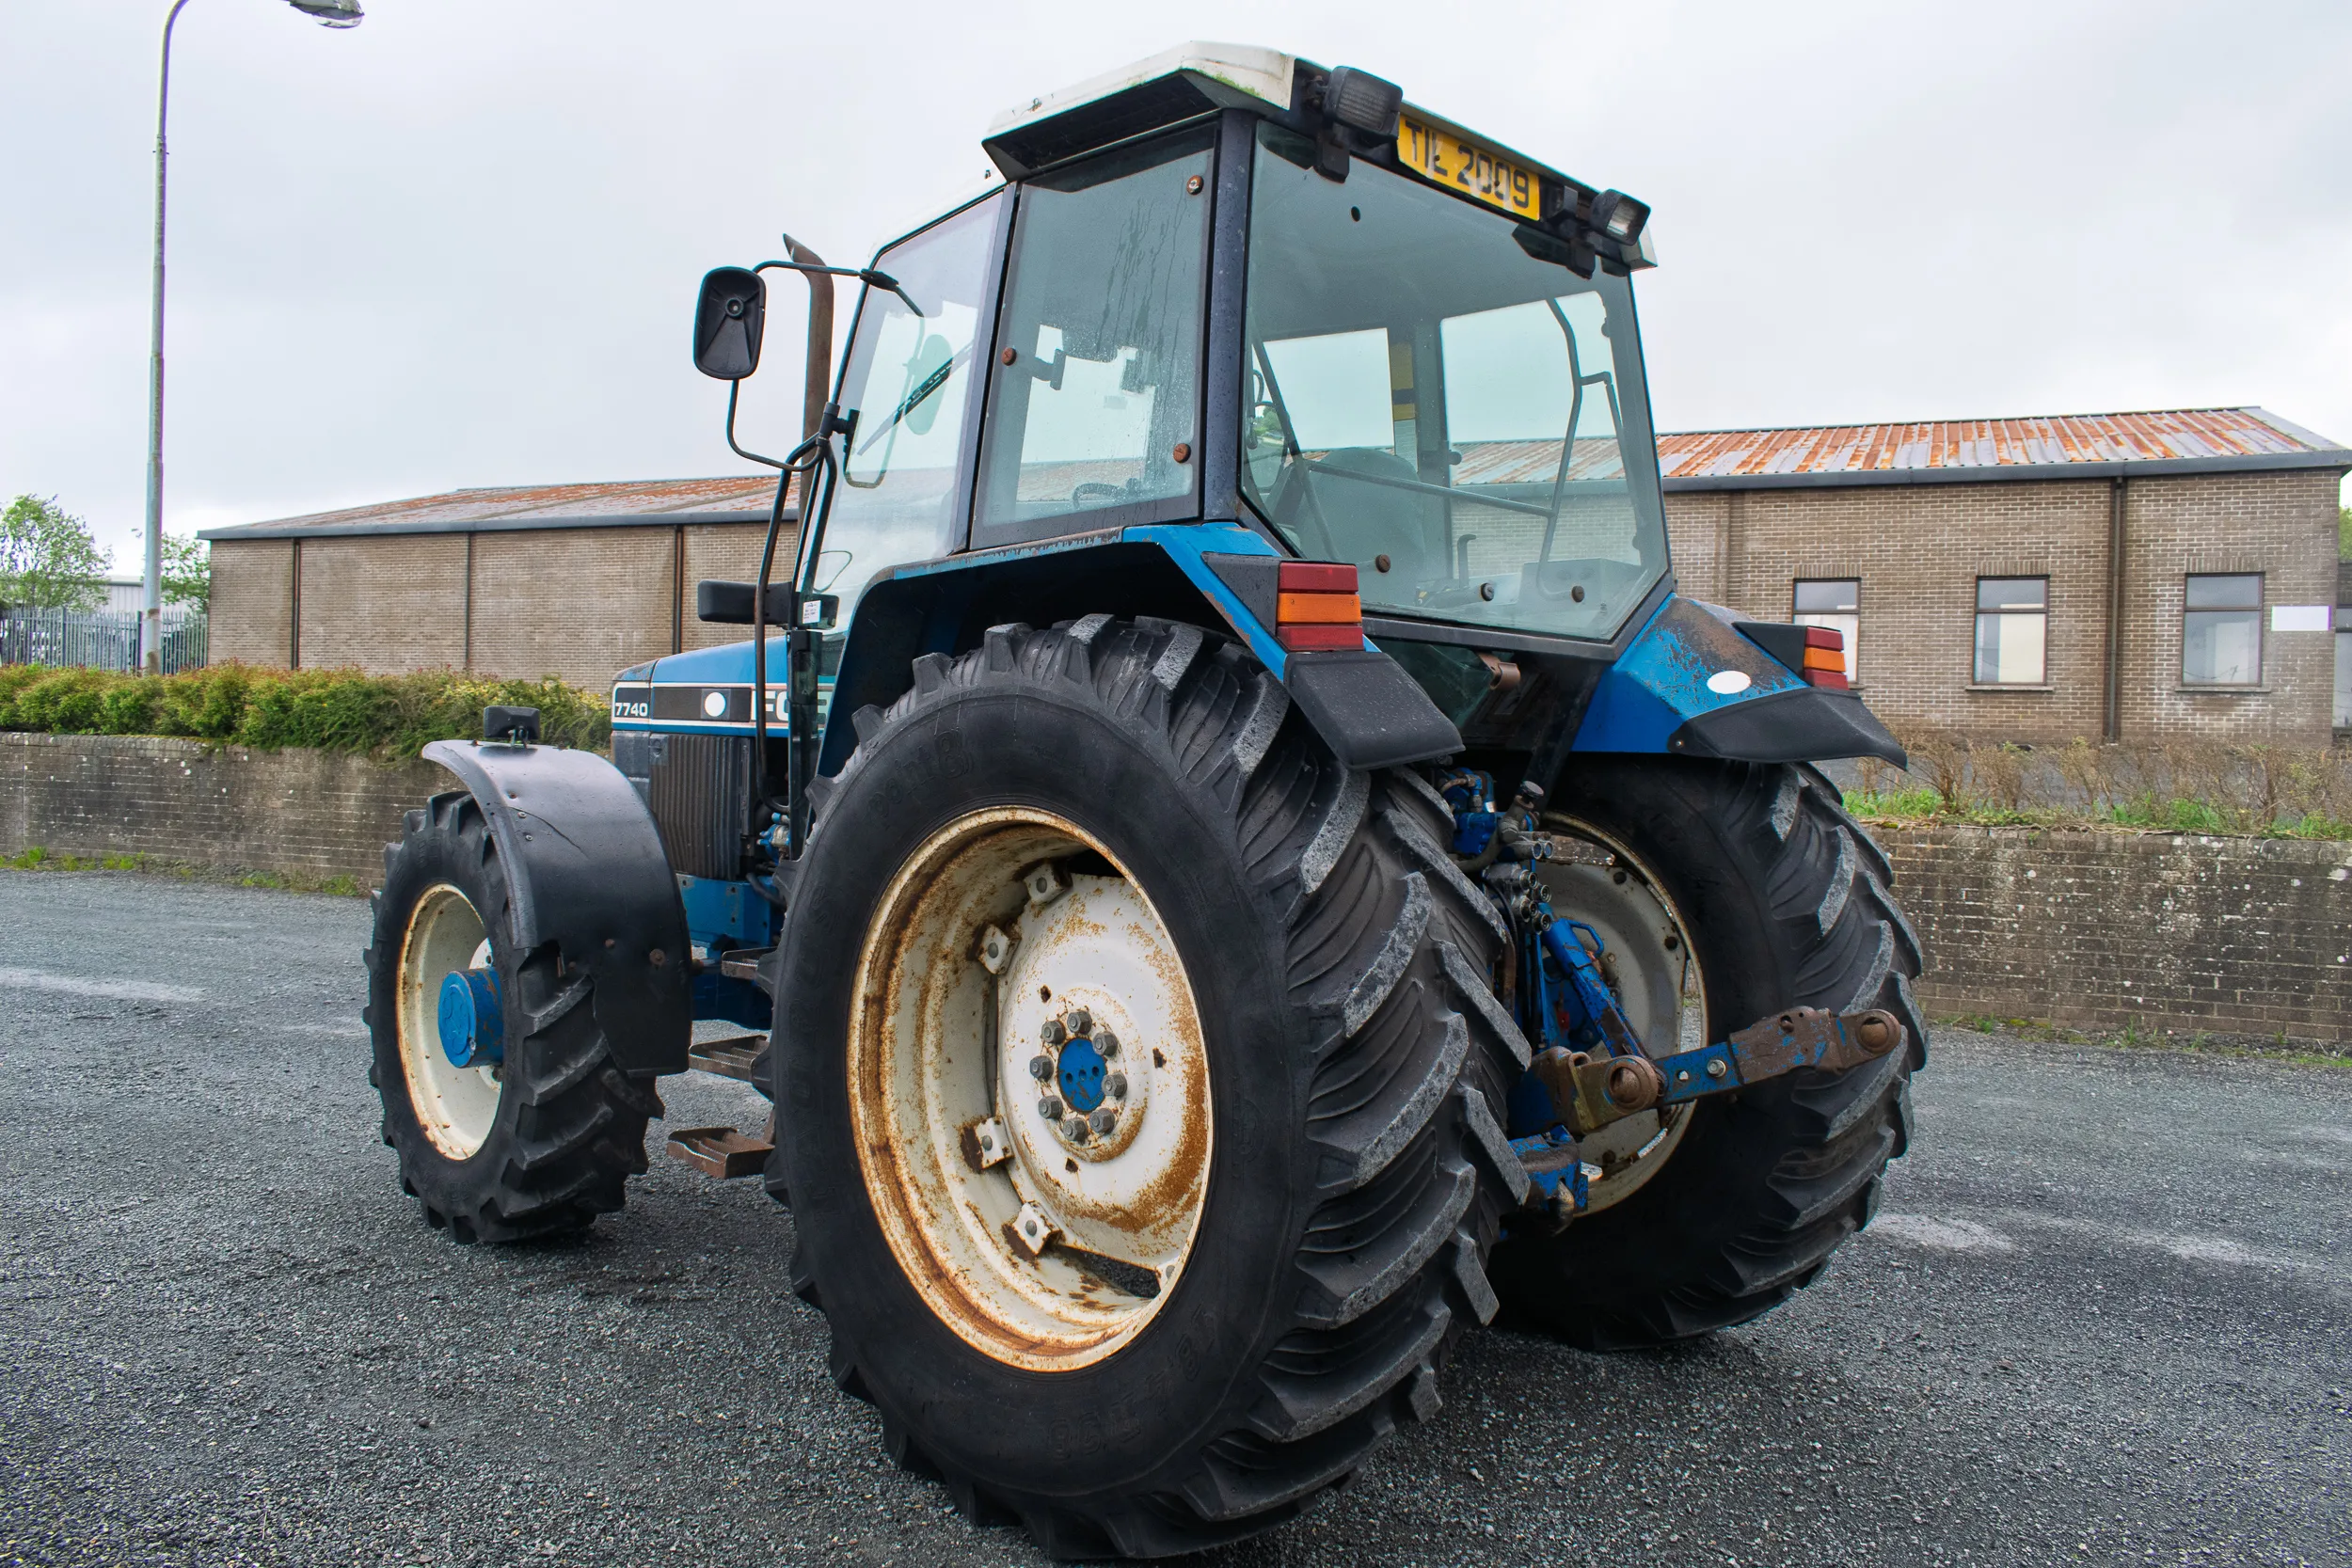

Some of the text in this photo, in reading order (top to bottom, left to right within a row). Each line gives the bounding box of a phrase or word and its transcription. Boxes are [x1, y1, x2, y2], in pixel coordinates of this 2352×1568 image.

[1406, 120, 1529, 209] TIL 2009
[614, 702, 649, 717] 7740
